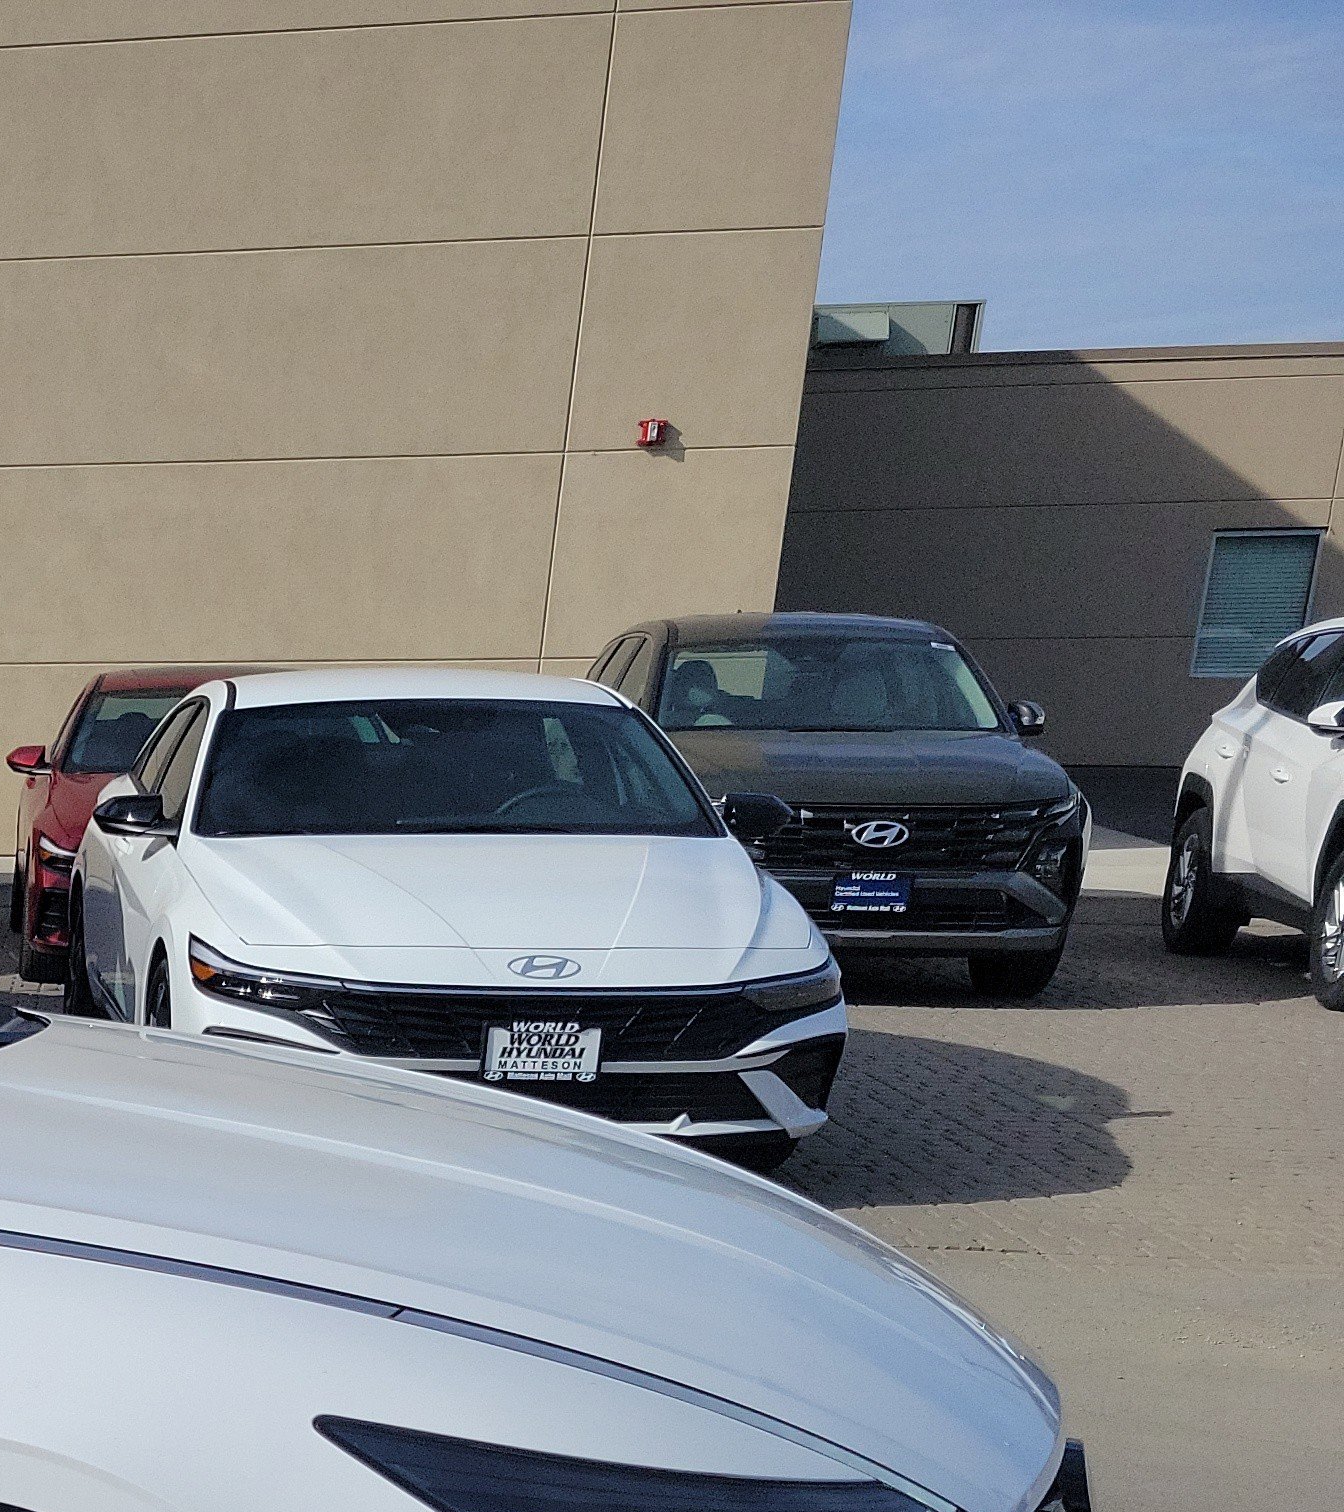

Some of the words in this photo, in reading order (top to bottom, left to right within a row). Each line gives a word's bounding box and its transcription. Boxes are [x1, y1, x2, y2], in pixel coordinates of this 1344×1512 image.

[851, 872, 897, 881] WORLD
[512, 1021, 580, 1033] WORLD
[510, 1033, 580, 1046] WORLD
[499, 1047, 586, 1058] HYUNDAI
[498, 1060, 582, 1070] MATTESON
